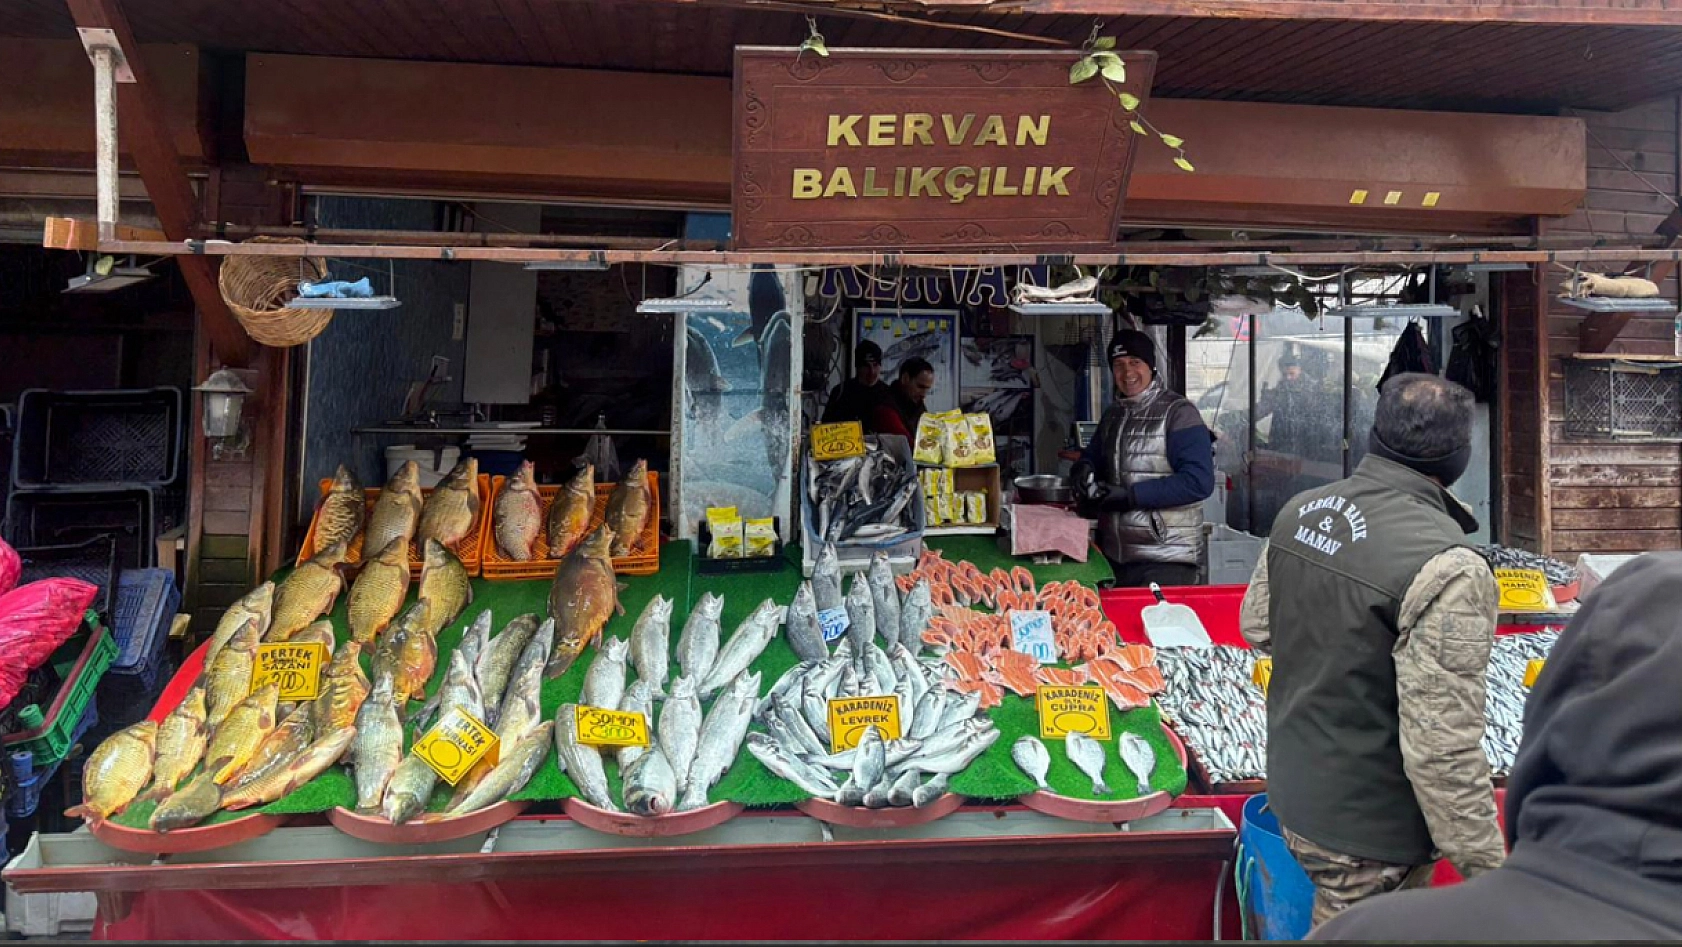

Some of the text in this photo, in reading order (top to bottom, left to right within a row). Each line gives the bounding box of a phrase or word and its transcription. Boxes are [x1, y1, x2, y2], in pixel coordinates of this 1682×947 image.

[827, 113, 1051, 146] KERVAN
[792, 167, 1075, 203] BALIKÇILIK
[1298, 495, 1367, 543] KERVAN BALIK
[1319, 515, 1333, 533] &
[1294, 525, 1342, 556] MANAV
[261, 648, 313, 662] PERTEK
[262, 662, 311, 672] SAZANI
[1044, 689, 1101, 703] KARADENİZ
[835, 700, 893, 715] KARADENİZ
[841, 714, 889, 725] LEVREK
